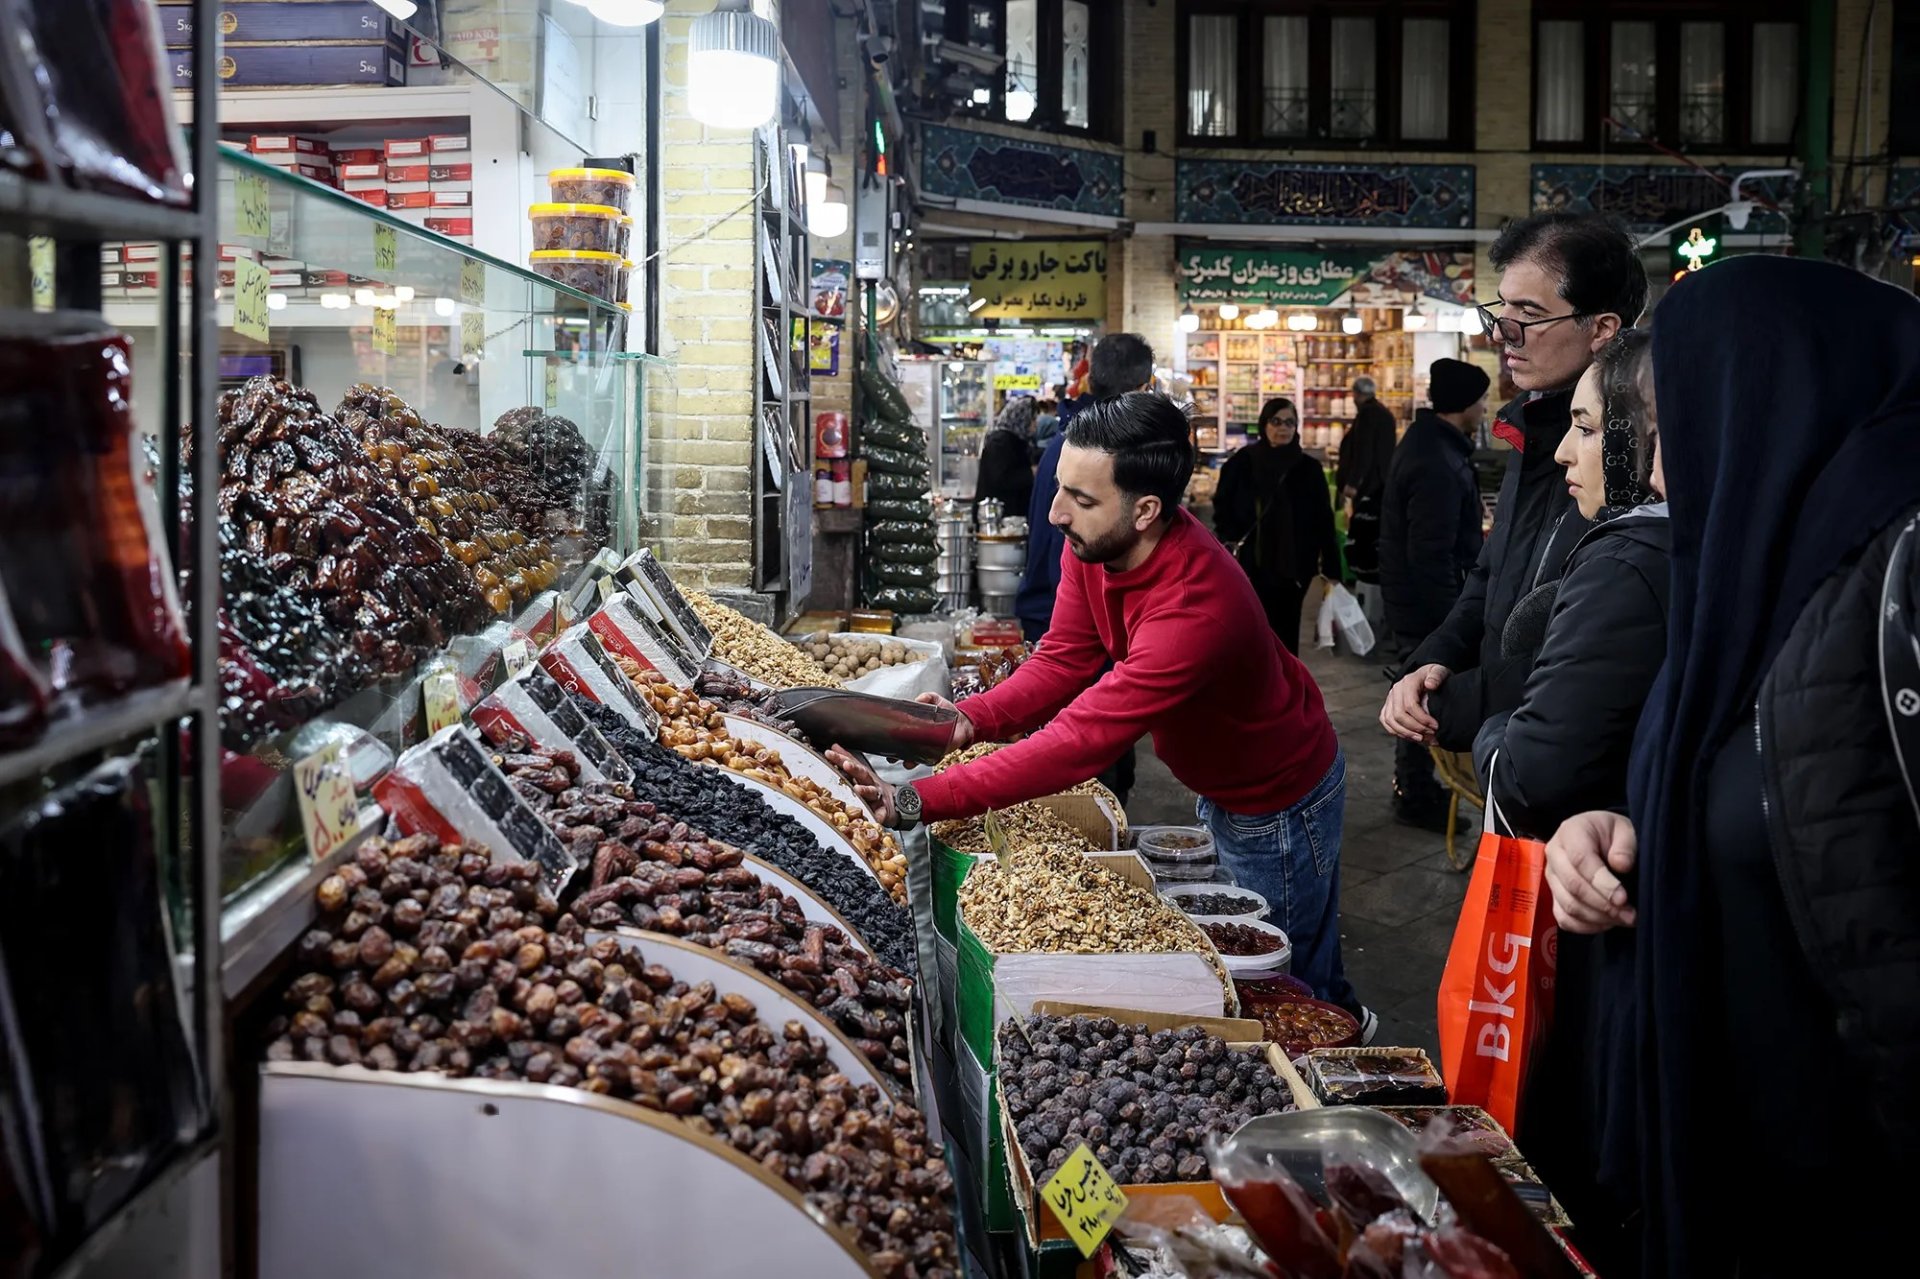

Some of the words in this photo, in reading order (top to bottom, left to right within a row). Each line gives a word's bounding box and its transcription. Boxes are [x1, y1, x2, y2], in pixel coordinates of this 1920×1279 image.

[972, 248, 1014, 281] برقی
[1065, 250, 1107, 282] پاکت
[1178, 255, 1233, 284] گلبرگ
[1299, 260, 1354, 286] عطاری
[991, 292, 1023, 311] مصرف
[1027, 291, 1052, 311] یکبار
[1055, 291, 1088, 312] ظروف
[1073, 1160, 1101, 1203] چیپس
[1053, 1180, 1073, 1217] خرما
